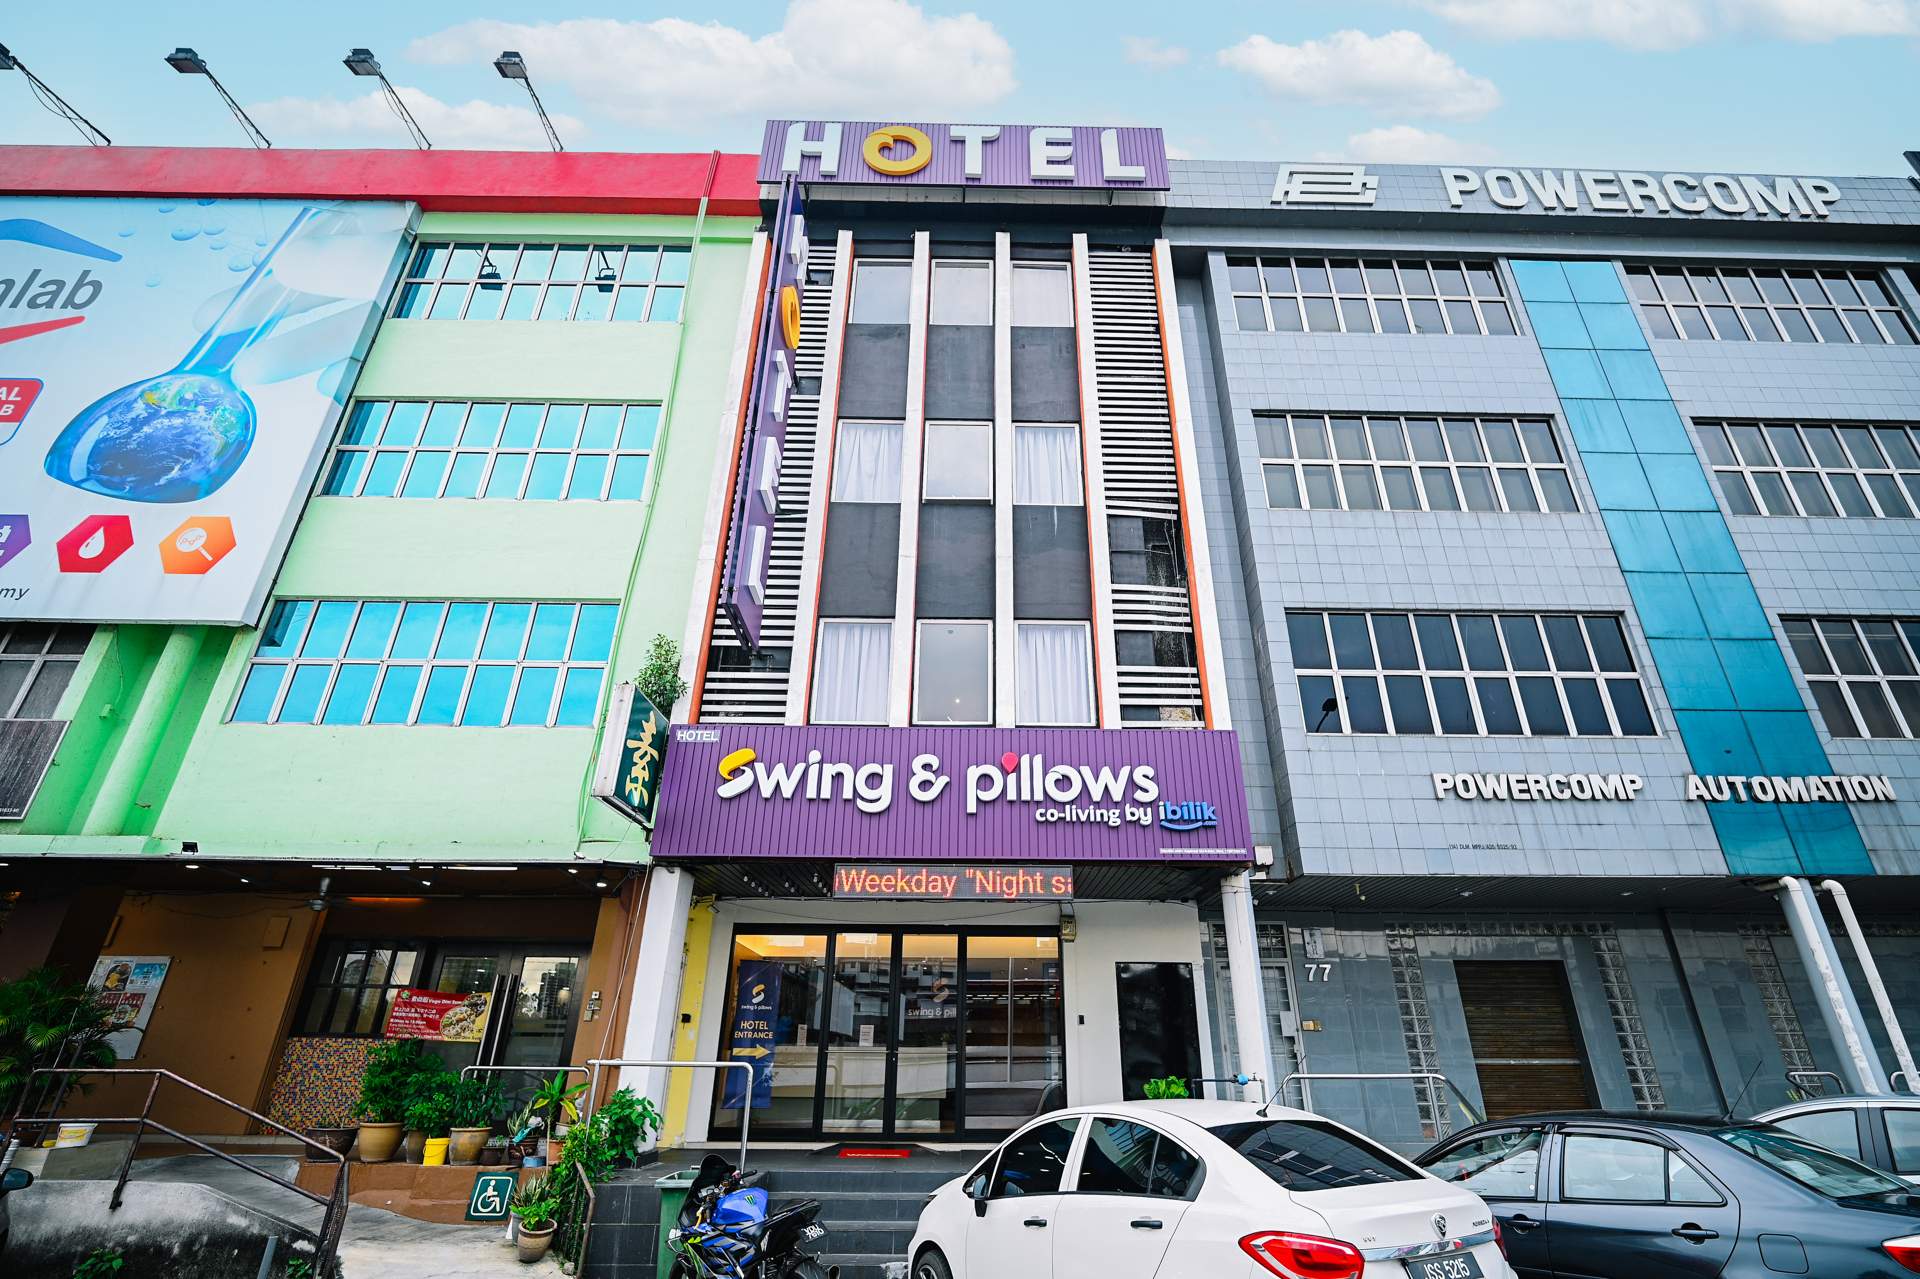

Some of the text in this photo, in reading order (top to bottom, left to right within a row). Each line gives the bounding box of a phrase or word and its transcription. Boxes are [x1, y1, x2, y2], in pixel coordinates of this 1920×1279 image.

[781, 122, 1146, 182] HOTEL
[1439, 167, 1841, 217] POWERCOMP
[748, 214, 809, 605] HOTEL
[676, 730, 719, 742] HOTEL
[909, 753, 951, 803] &
[966, 751, 1160, 815] pillows
[1432, 772, 1643, 800] POWERCOMP
[1687, 774, 1897, 802] AUTOMATION
[1035, 801, 1218, 827] co-living by ibilik
[1304, 964, 1332, 982] 77
[740, 1020, 769, 1030] HOTEL
[908, 1007, 934, 1018] swing
[935, 1007, 942, 1016] &
[734, 1030, 774, 1039] ENTRANCE
[1423, 1257, 1471, 1279] JSS 5215
